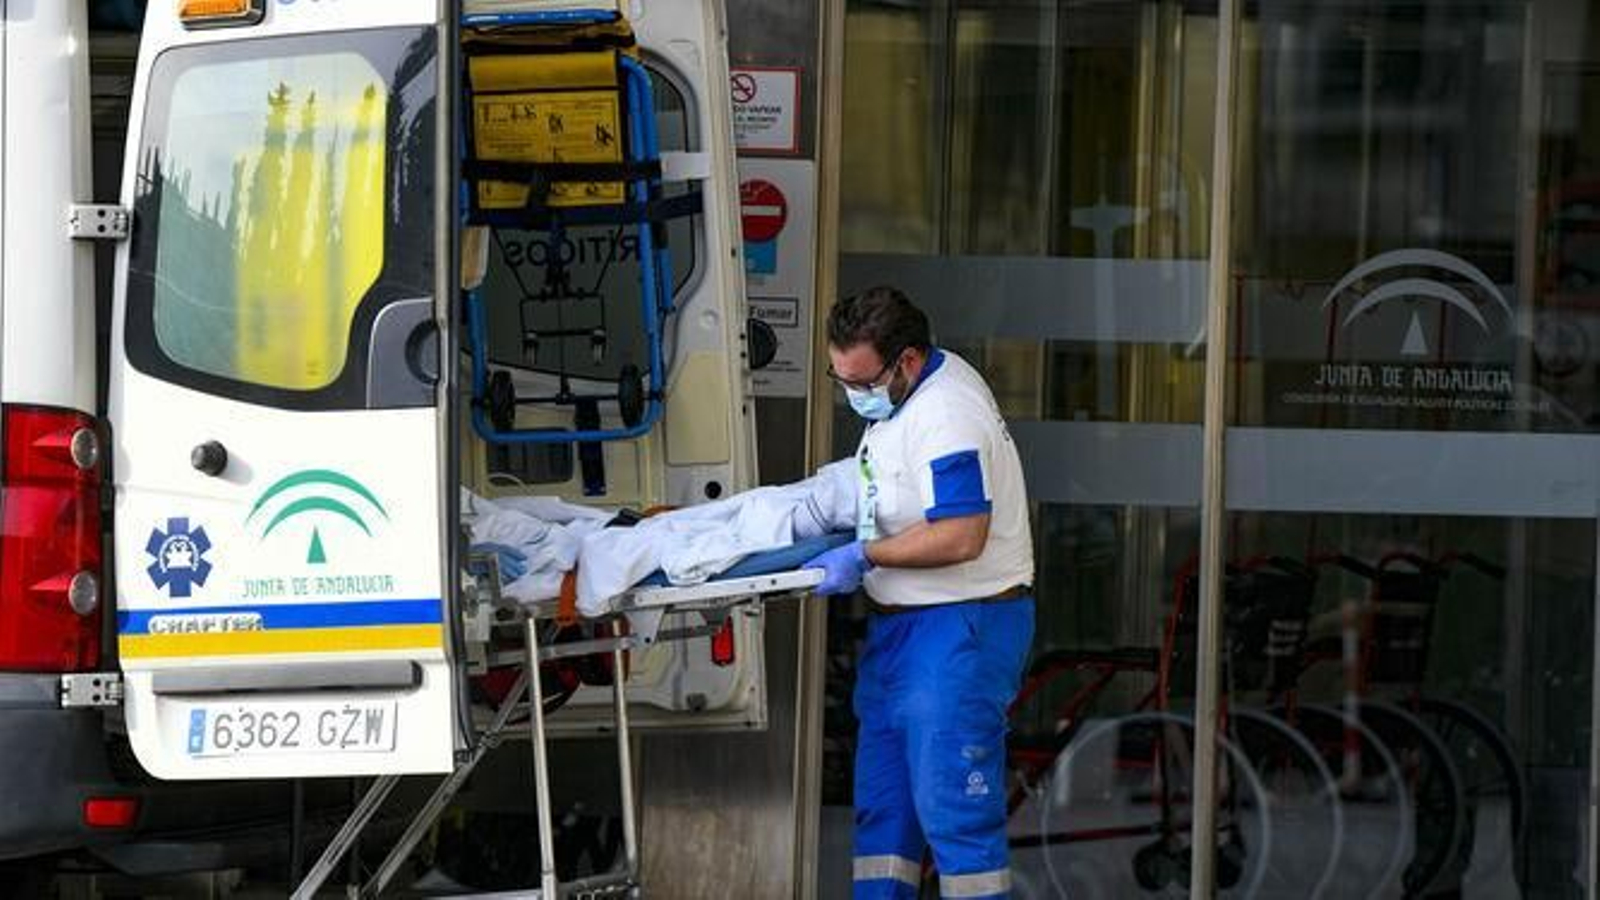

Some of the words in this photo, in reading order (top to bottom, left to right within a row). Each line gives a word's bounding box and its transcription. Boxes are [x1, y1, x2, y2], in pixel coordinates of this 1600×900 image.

[749, 306, 793, 321] Fumar
[1315, 364, 1373, 386] JUNTA
[1381, 366, 1404, 387] DE
[1412, 368, 1512, 392] ANDALUCIA
[242, 578, 285, 598] JUNTA
[292, 576, 309, 595] DE
[315, 574, 394, 595] ANDALUCIA
[213, 712, 301, 748] 6362
[317, 709, 384, 746] GZW
